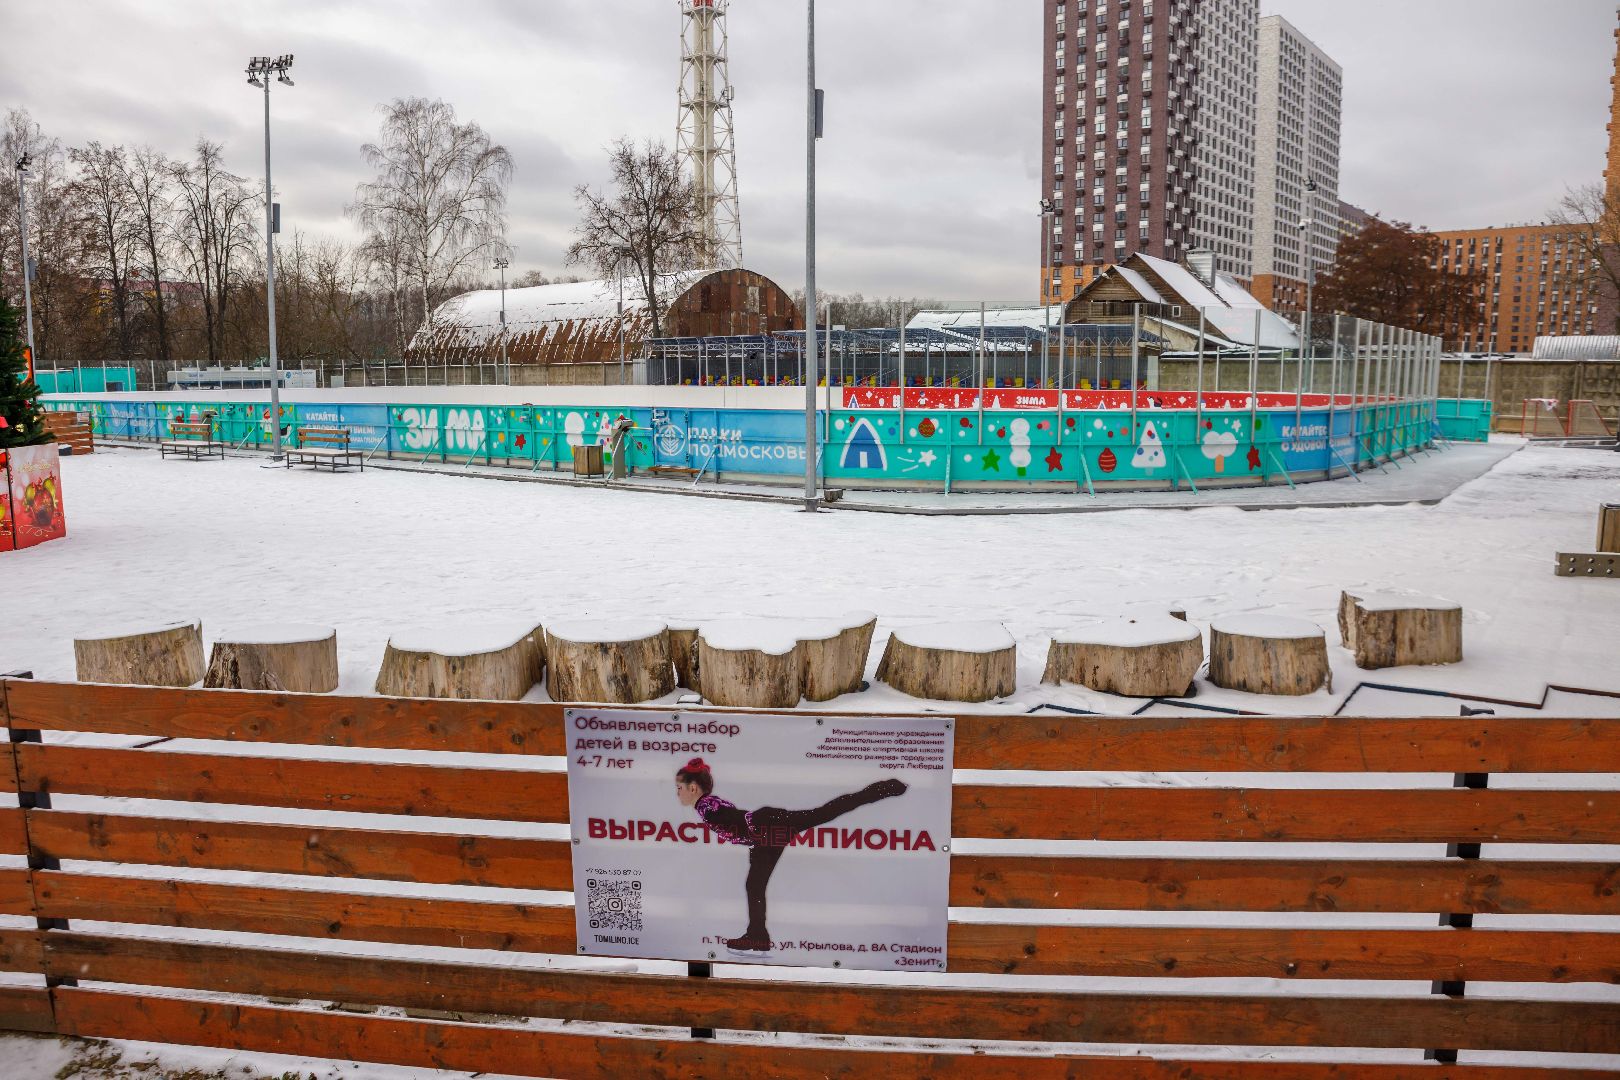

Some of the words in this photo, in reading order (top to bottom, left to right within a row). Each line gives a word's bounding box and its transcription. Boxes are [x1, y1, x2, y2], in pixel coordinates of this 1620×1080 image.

[1015, 396, 1047, 405] ЗИМА
[402, 407, 487, 452] ЗИМА
[687, 427, 742, 441] ПАРКИ
[1282, 424, 1328, 437] КАТАЙТЕС
[575, 716, 682, 732] Объявляется
[687, 720, 740, 738] набор
[575, 737, 623, 750] детей
[628, 741, 637, 750] в
[642, 741, 717, 755] возрасте
[576, 756, 603, 768] 4-7
[606, 759, 634, 769] лет
[594, 934, 640, 945] TOMILINO.ICE
[702, 936, 713, 944] п.
[780, 941, 796, 951] ул.
[799, 940, 856, 952] Крылова,
[857, 944, 869, 953] д.
[871, 943, 888, 952] 8А
[890, 943, 942, 954] Стадион
